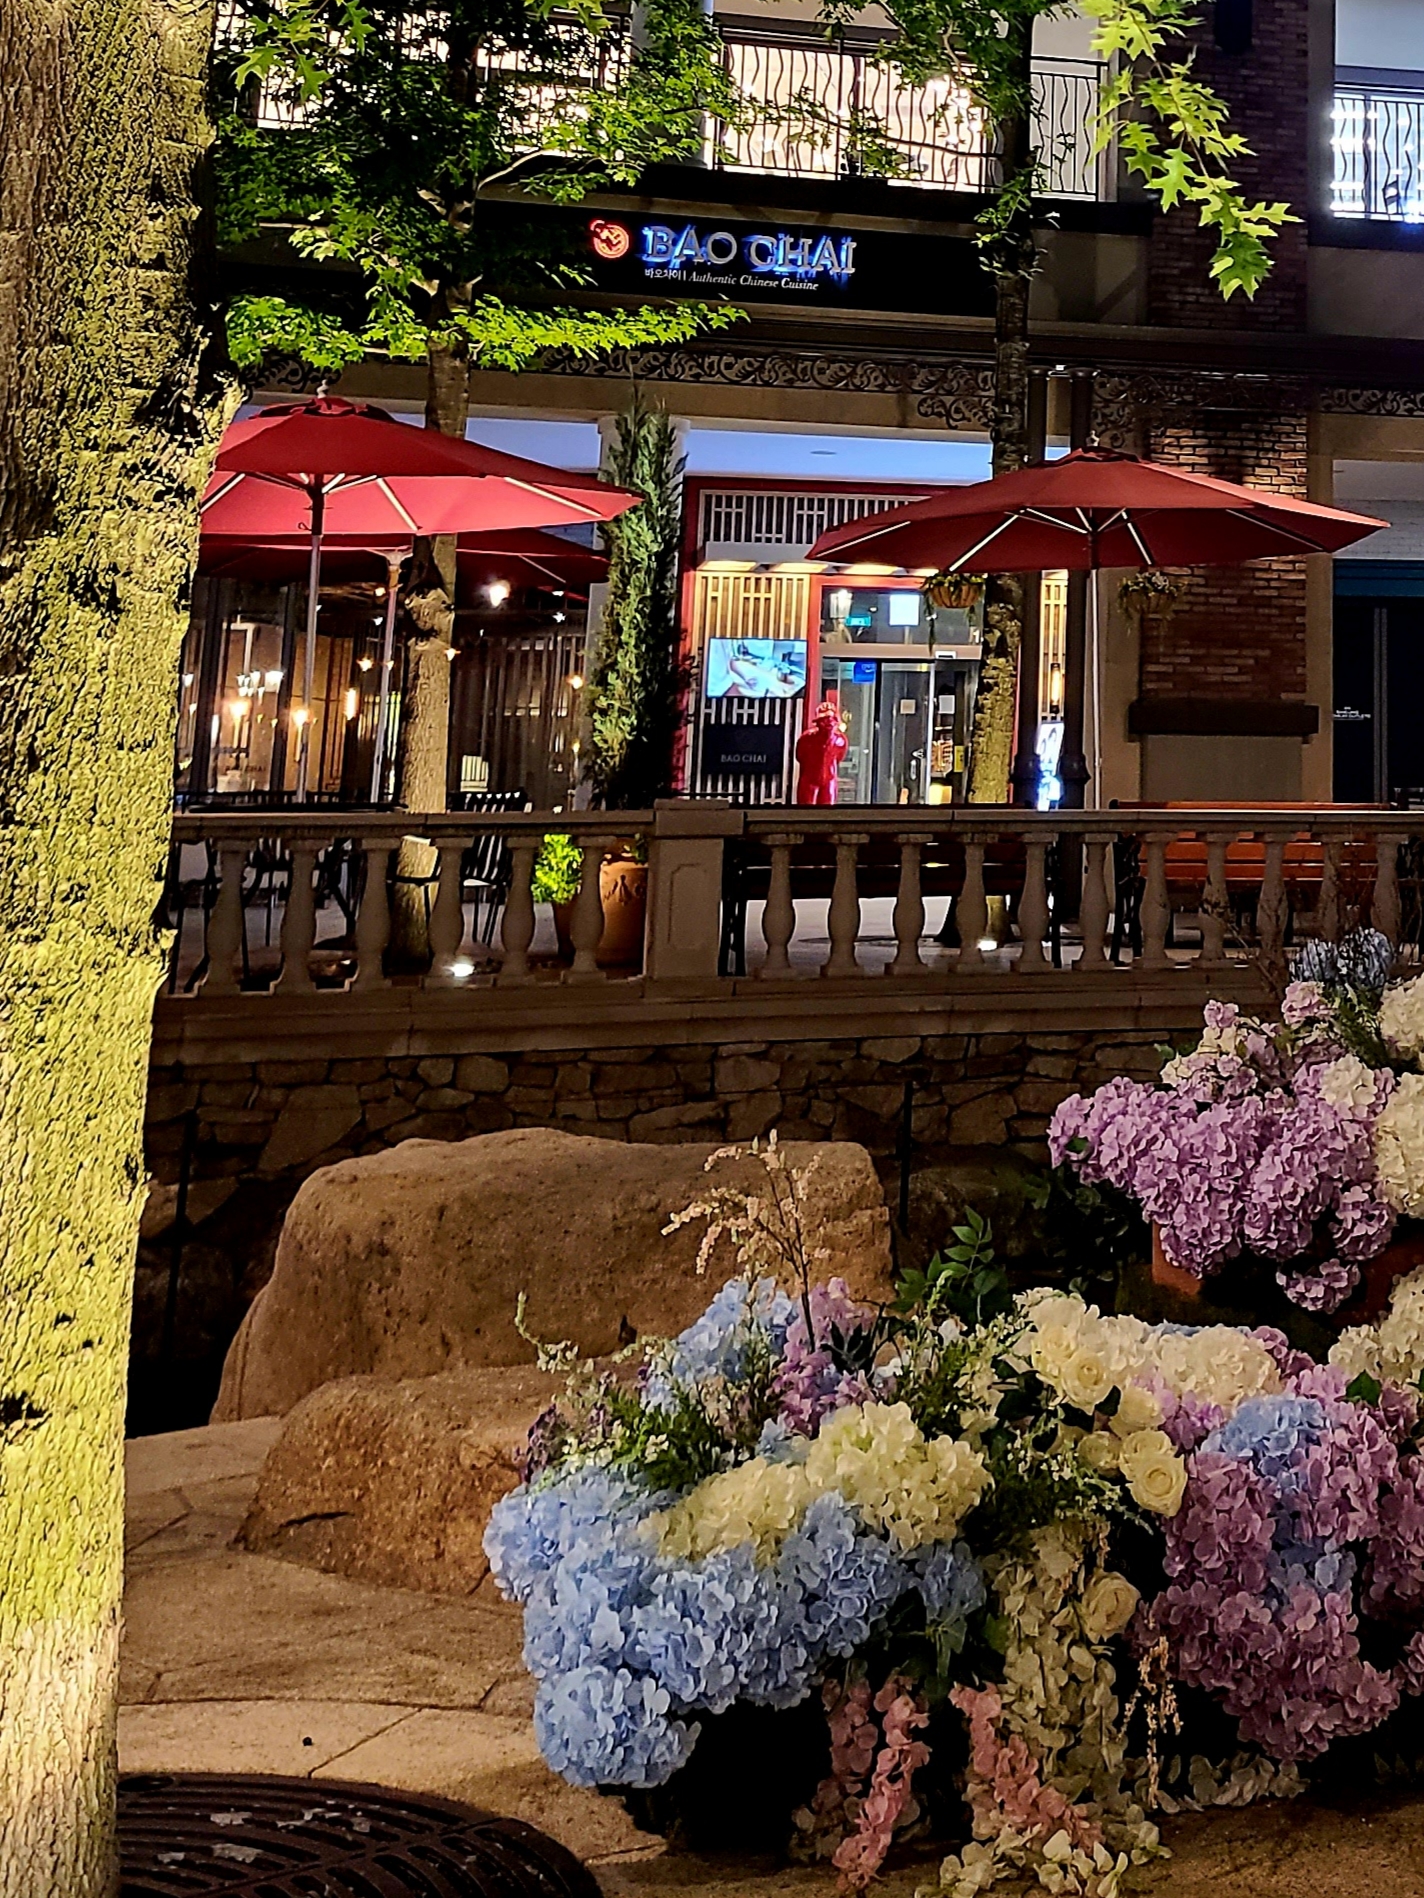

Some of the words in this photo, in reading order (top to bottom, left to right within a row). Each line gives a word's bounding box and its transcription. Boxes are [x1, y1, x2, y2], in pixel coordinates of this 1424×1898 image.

[644, 224, 738, 265] BAO
[747, 233, 858, 274] CHAI
[688, 270, 737, 285] Authentic
[740, 274, 779, 288] Chinese
[781, 277, 819, 291] Cuisine
[720, 754, 741, 763] BAO
[742, 754, 767, 763] CHAI
